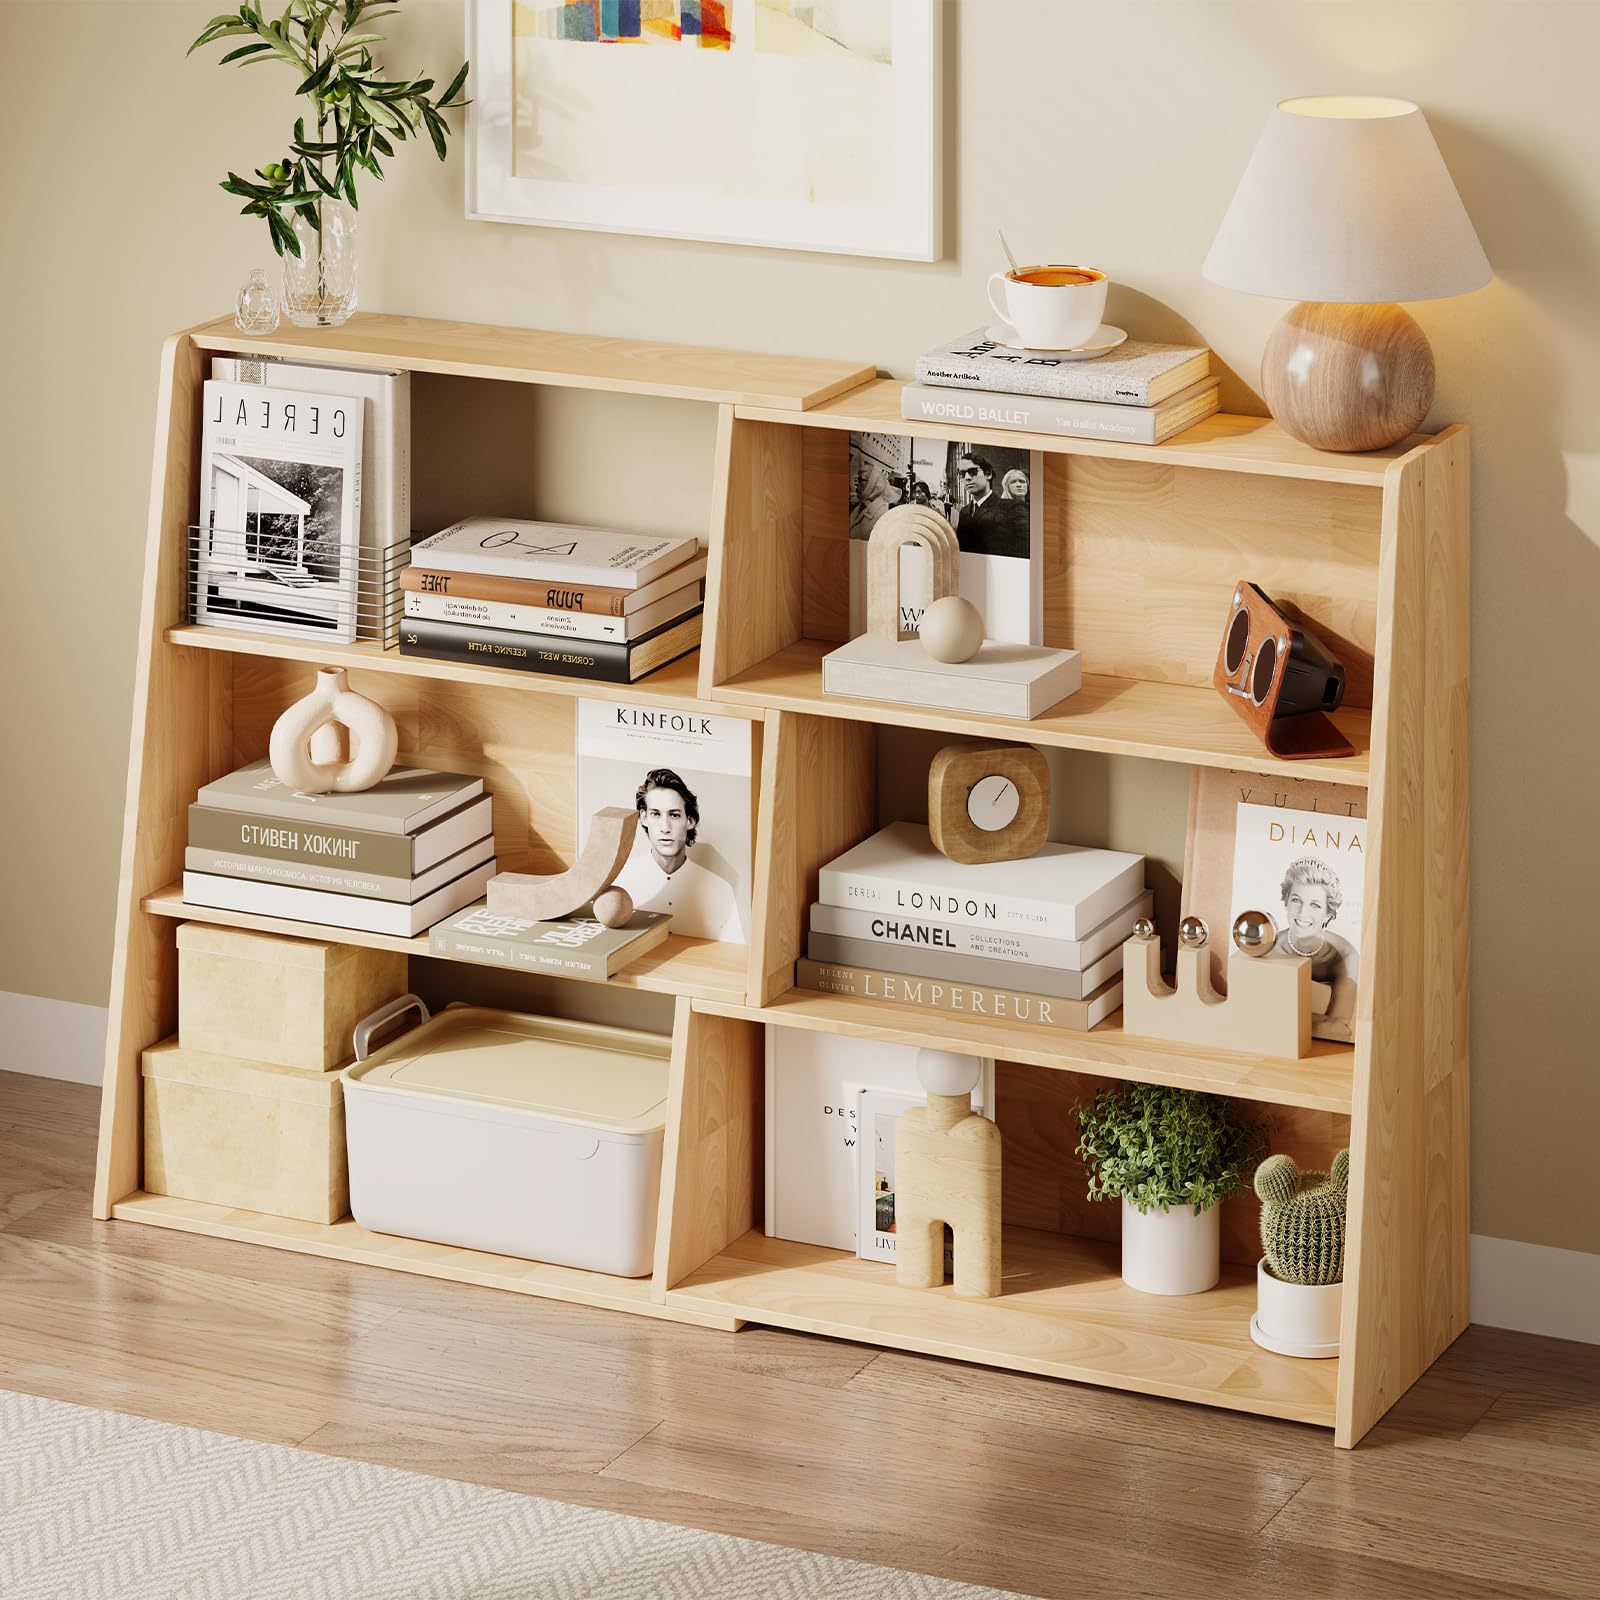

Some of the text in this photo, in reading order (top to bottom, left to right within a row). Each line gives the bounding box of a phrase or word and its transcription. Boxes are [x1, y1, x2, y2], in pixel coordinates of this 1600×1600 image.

[927, 370, 952, 378] Another
[921, 401, 1030, 425] WORLD BALLET
[616, 708, 712, 735] KINFOLK
[1240, 788, 1358, 817] VUIT
[241, 824, 360, 859] СТИВЕН ХОКИНГ
[1269, 822, 1363, 853] DIANA
[897, 889, 996, 919] LONDON
[871, 919, 957, 948] CHANEL
[970, 934, 1021, 948] COLLECTIONS
[970, 943, 1029, 958] AND CREATIONS
[819, 981, 855, 992] OLIVIER
[863, 974, 1055, 1024] LEMPEREUR
